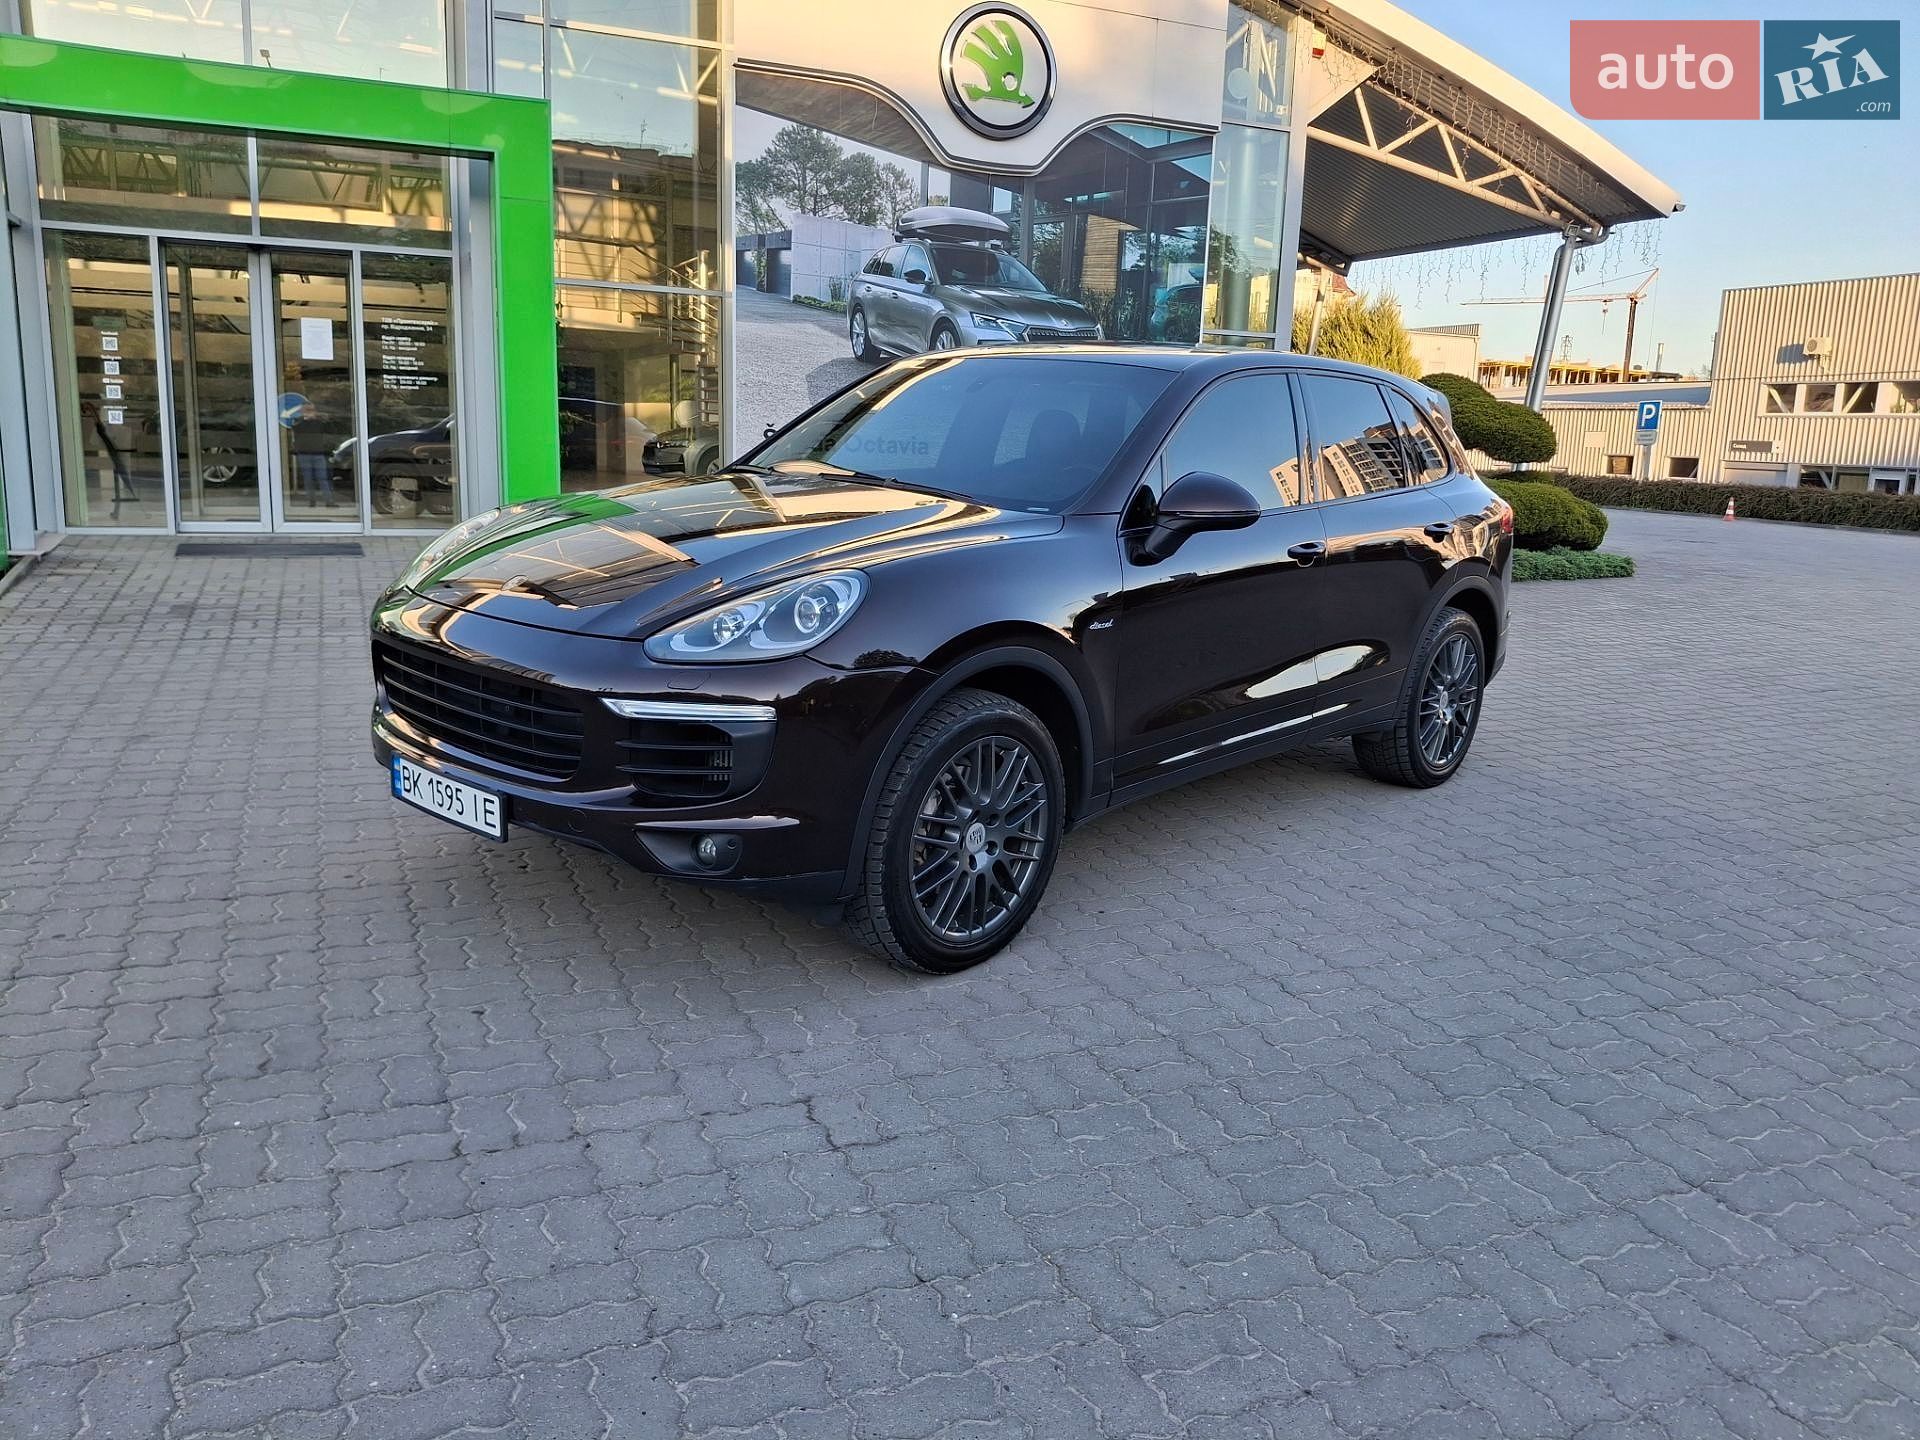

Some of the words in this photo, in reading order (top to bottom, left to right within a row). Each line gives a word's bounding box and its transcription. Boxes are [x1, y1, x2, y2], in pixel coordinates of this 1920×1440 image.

[1641, 404, 1656, 427] P
[845, 436, 929, 456] Octavia
[402, 765, 423, 799] BK
[427, 777, 464, 816] 1595
[474, 794, 497, 829] IE
